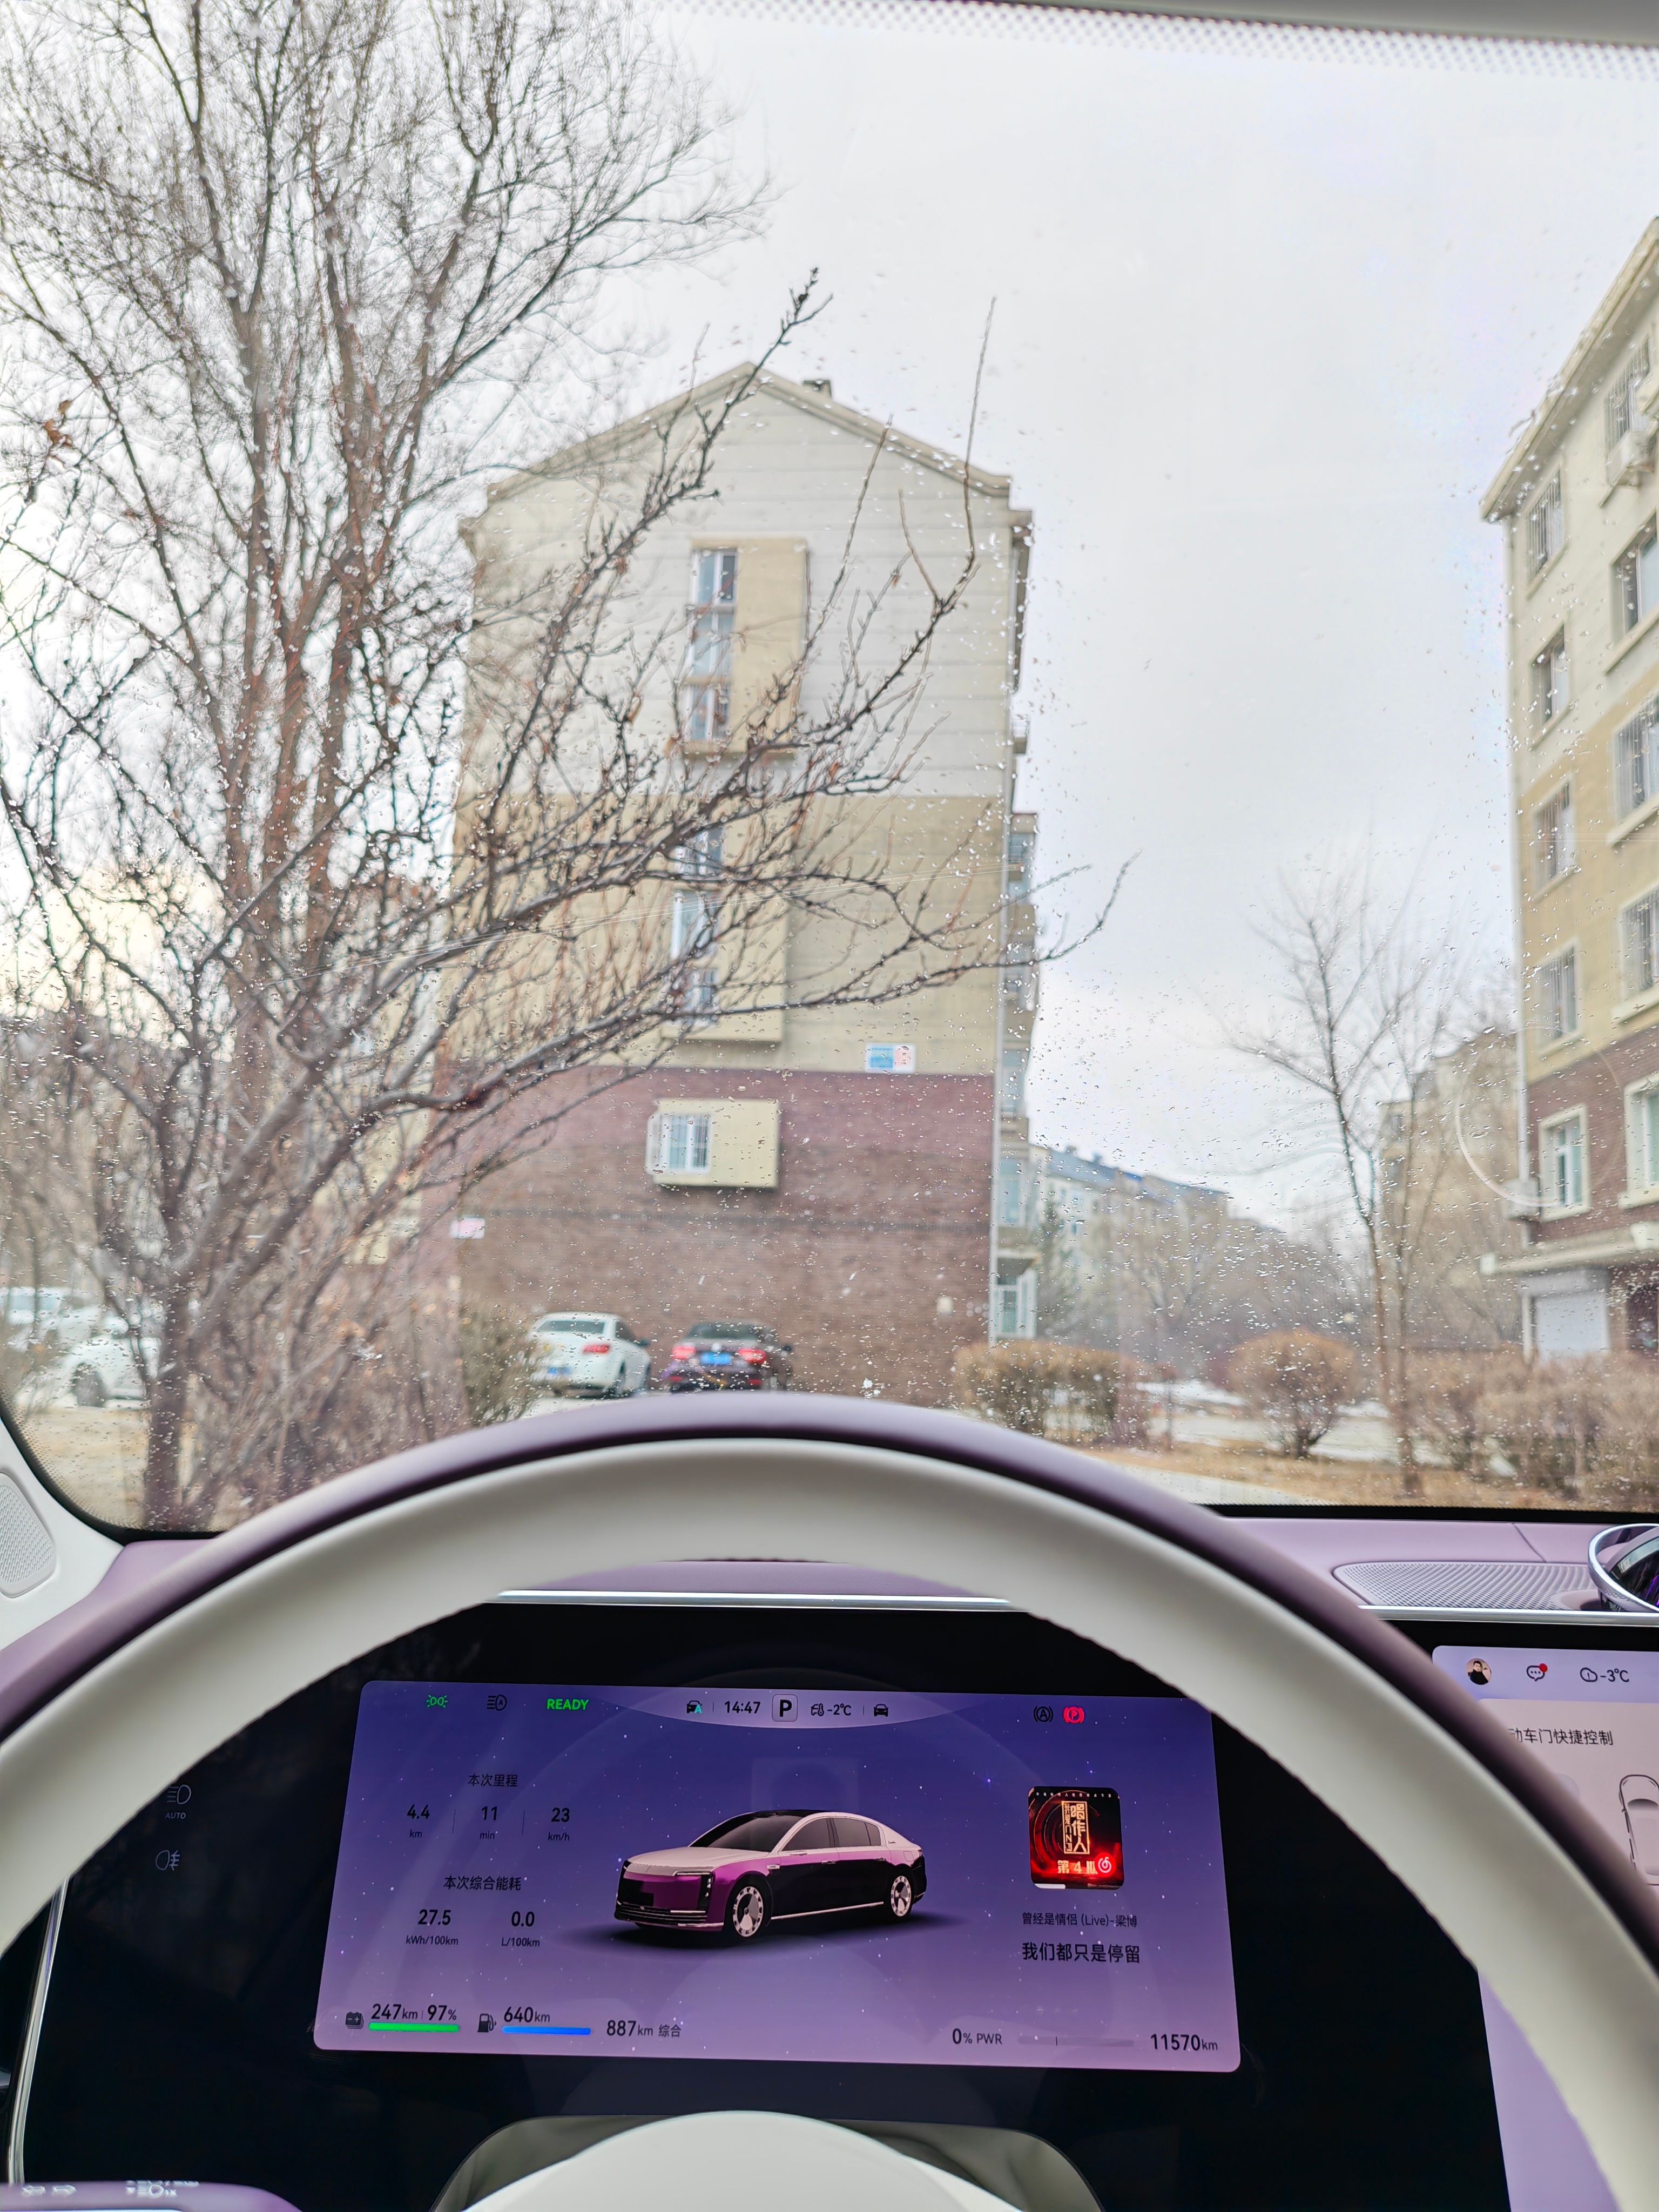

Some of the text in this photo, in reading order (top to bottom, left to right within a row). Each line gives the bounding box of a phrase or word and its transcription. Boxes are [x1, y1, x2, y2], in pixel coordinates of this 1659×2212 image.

[547, 1698, 589, 1711] READY
[725, 1701, 760, 1714] 14:47
[779, 1700, 792, 1717] P
[468, 1773, 518, 1788] 本次里程
[407, 1804, 430, 1819] 4.4
[481, 1806, 497, 1820] 11
[551, 1808, 570, 1823] 23
[410, 1829, 422, 1838] km
[480, 1831, 495, 1839] min
[548, 1831, 570, 1842] km/h
[443, 1876, 521, 1890] 本次综合能耗
[418, 1910, 451, 1926] 27.5
[511, 1911, 535, 1927] 0.0
[1022, 1912, 1077, 1926] 曾经是情侣
[406, 1935, 458, 1946] kWh/100km
[501, 1937, 540, 1947] L/100km
[1022, 1942, 1139, 1964] 我们都只是停留
[427, 2005, 457, 2021] 97%
[658, 2024, 682, 2038] 综合
[952, 2028, 1002, 2045] 0% PWR
